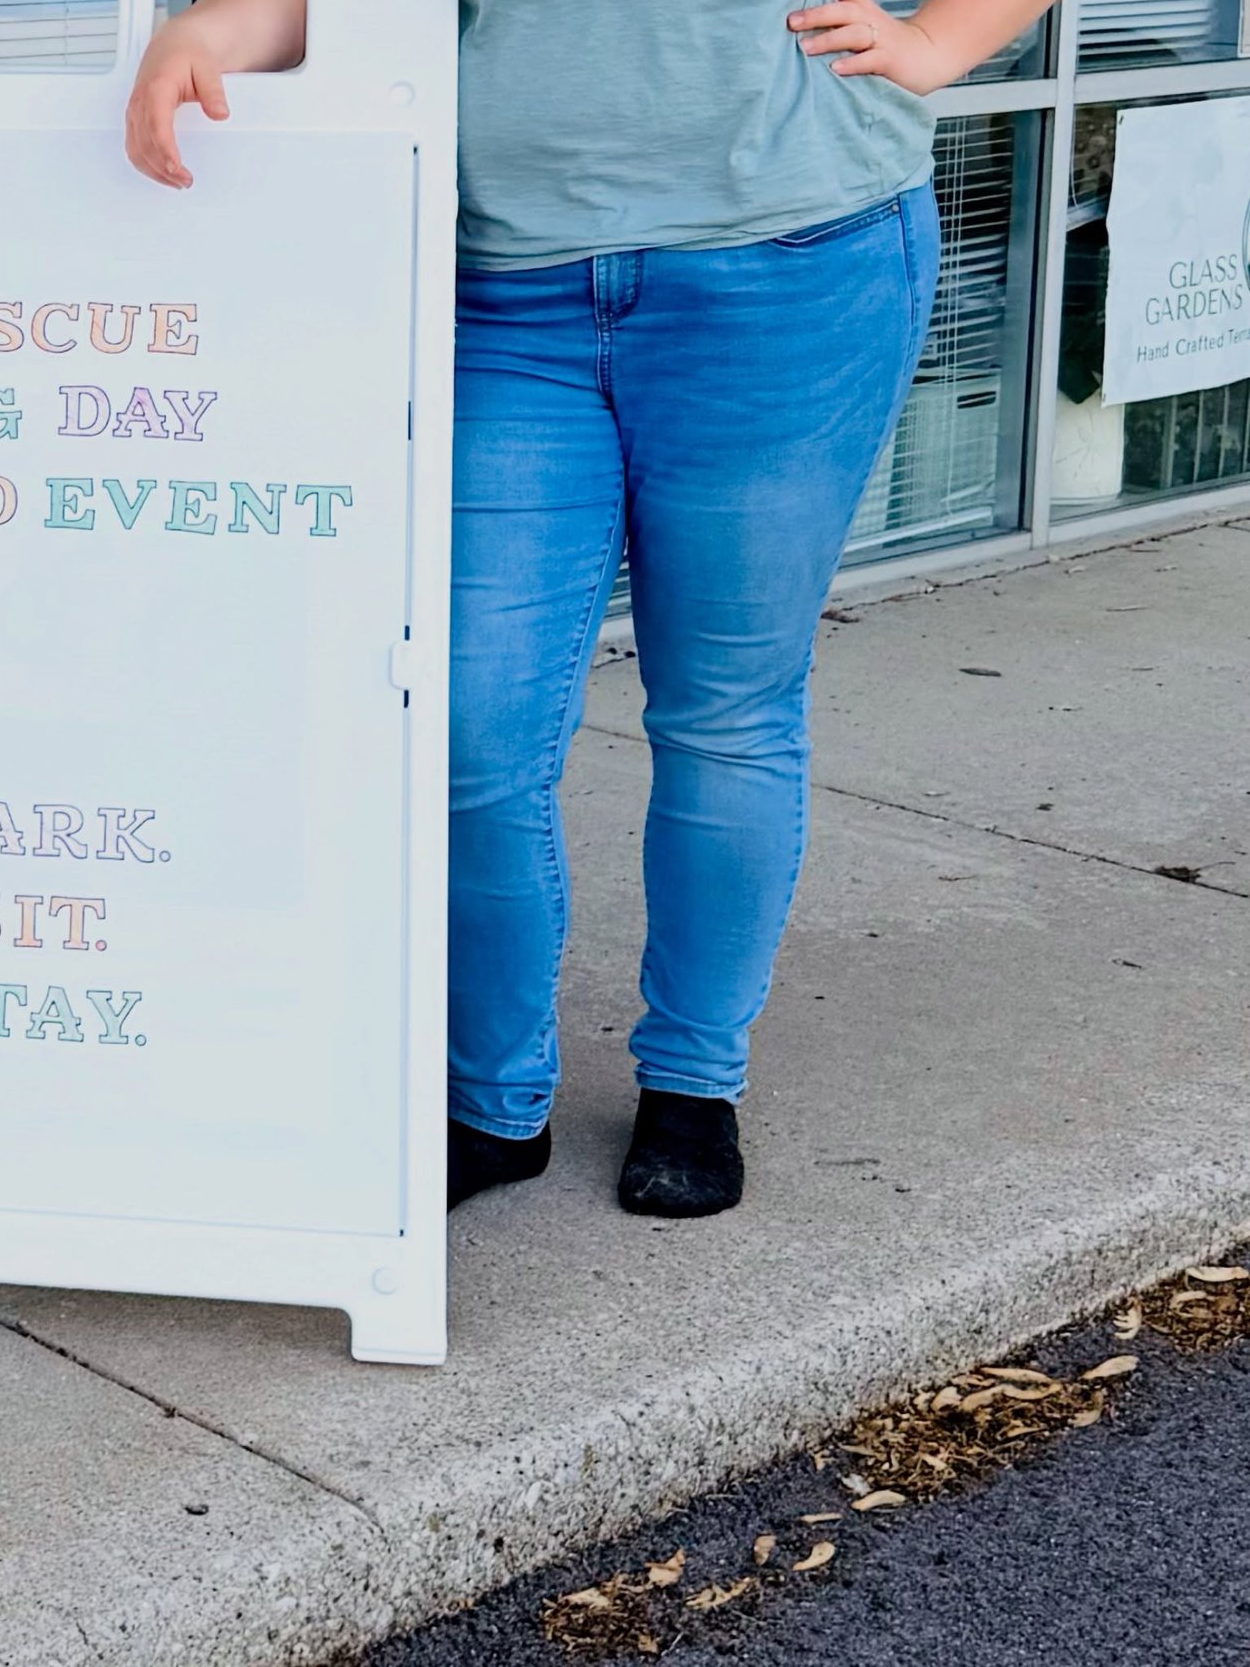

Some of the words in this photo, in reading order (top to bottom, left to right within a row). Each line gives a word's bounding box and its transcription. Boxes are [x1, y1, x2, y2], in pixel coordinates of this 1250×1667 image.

[1169, 254, 1237, 289] GLASS
[1146, 284, 1243, 325] GARDENS
[1137, 341, 1169, 363] Hand
[1176, 333, 1224, 356] Crafted
[58, 385, 218, 442] DAY
[43, 477, 353, 537] EVENT
